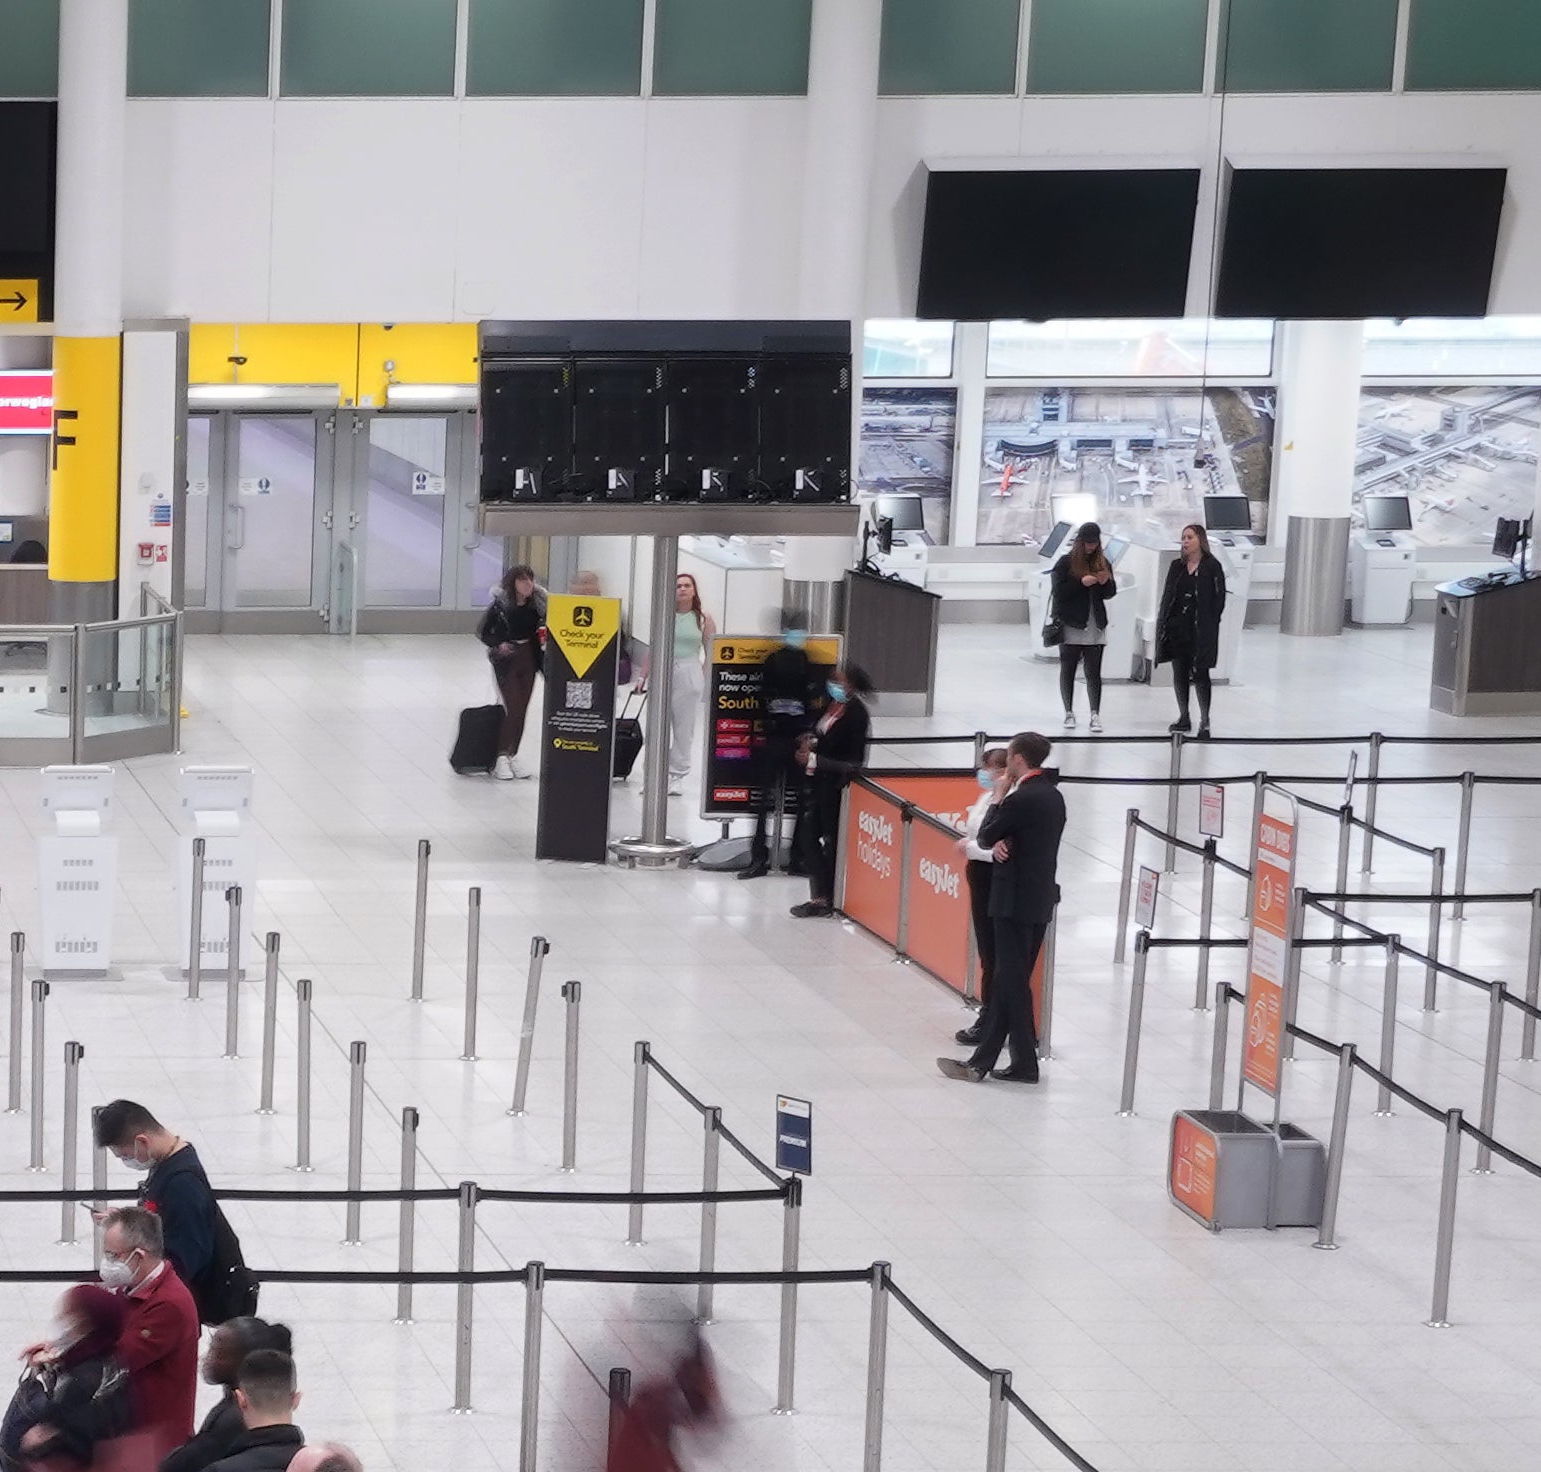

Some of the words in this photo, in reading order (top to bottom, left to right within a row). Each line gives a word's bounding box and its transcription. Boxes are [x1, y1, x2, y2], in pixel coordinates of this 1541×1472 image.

[53, 410, 78, 470] F
[559, 629, 585, 638] Check
[586, 631, 605, 641] your
[566, 638, 598, 649] Terminal
[719, 671, 747, 682] These
[718, 696, 759, 709] South
[858, 811, 893, 846] easyJet
[857, 832, 891, 879] holidays
[920, 858, 959, 899] easyJet
